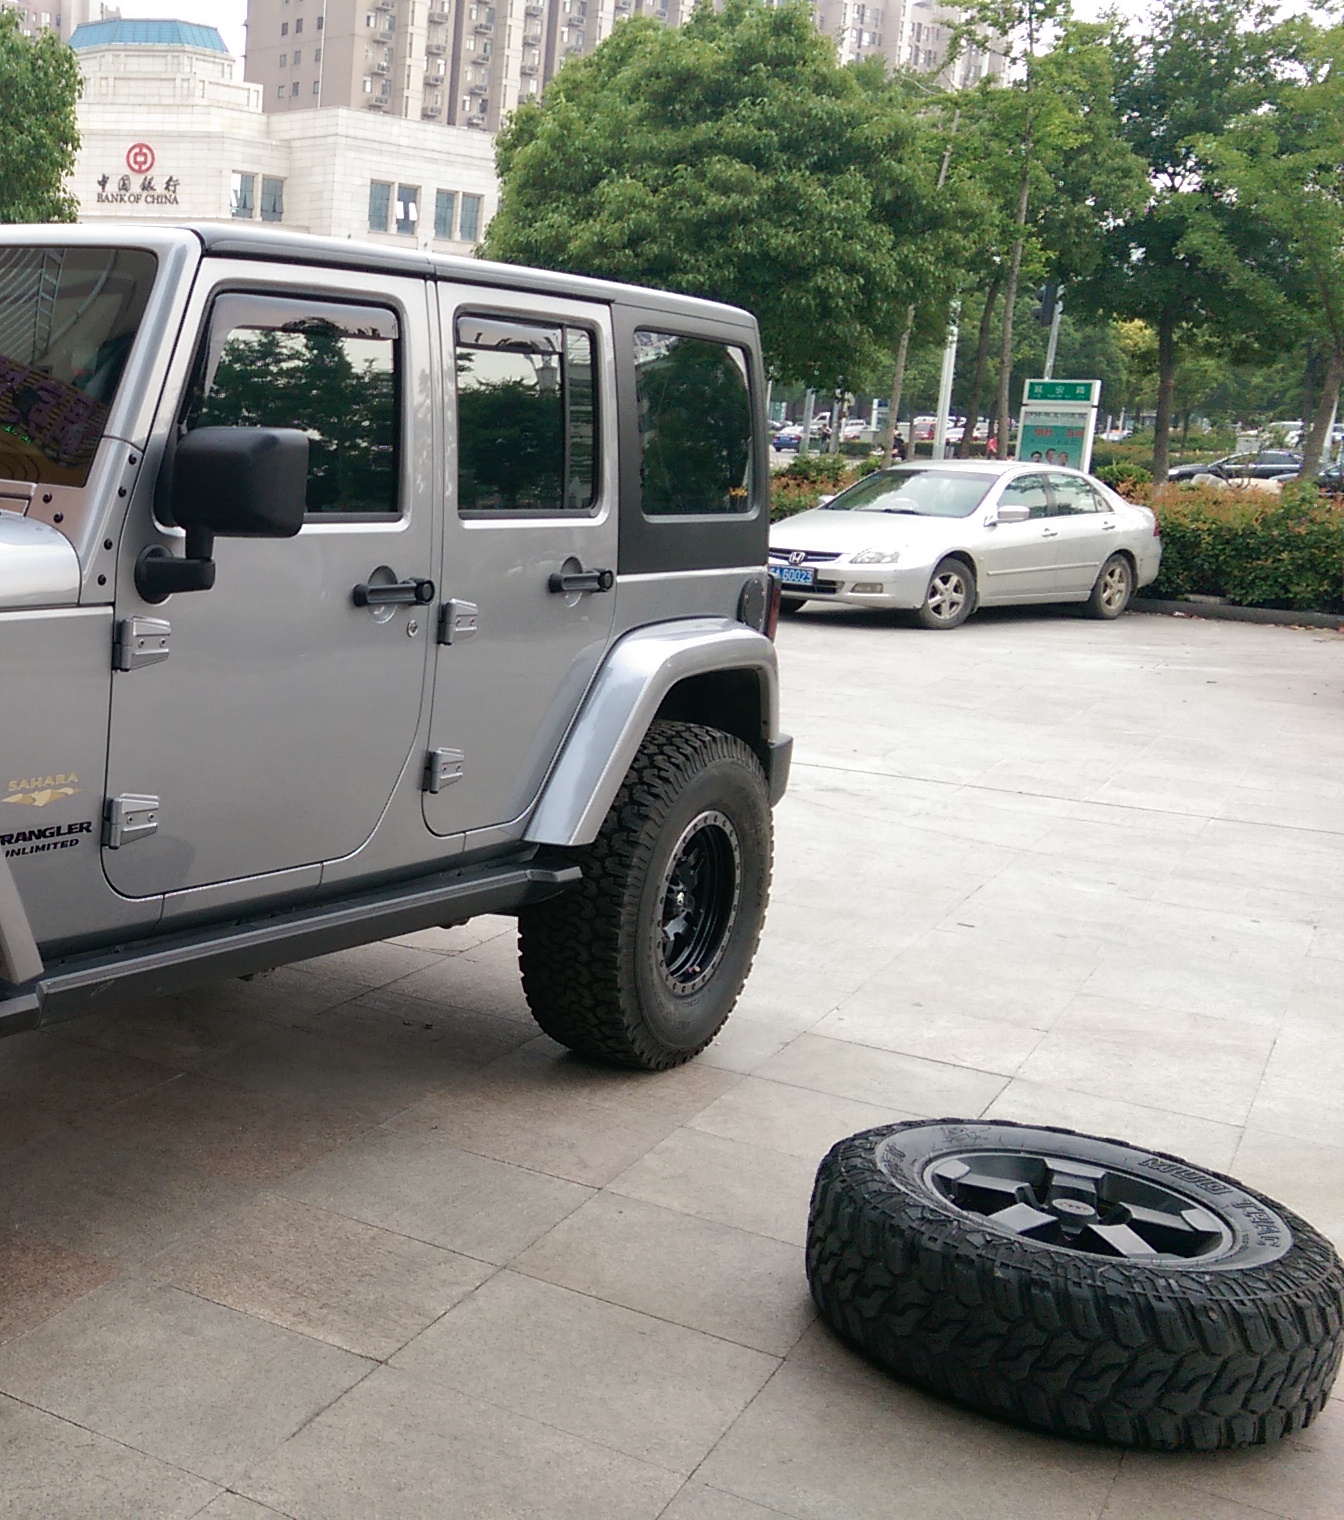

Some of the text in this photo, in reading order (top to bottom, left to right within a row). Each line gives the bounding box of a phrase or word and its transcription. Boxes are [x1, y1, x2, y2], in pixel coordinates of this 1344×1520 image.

[97, 173, 180, 194] 中国银行
[96, 192, 179, 205] BANK OF CHINA
[8, 772, 79, 791] SAHARA
[1138, 1157, 1281, 1248] MUD TRAC
